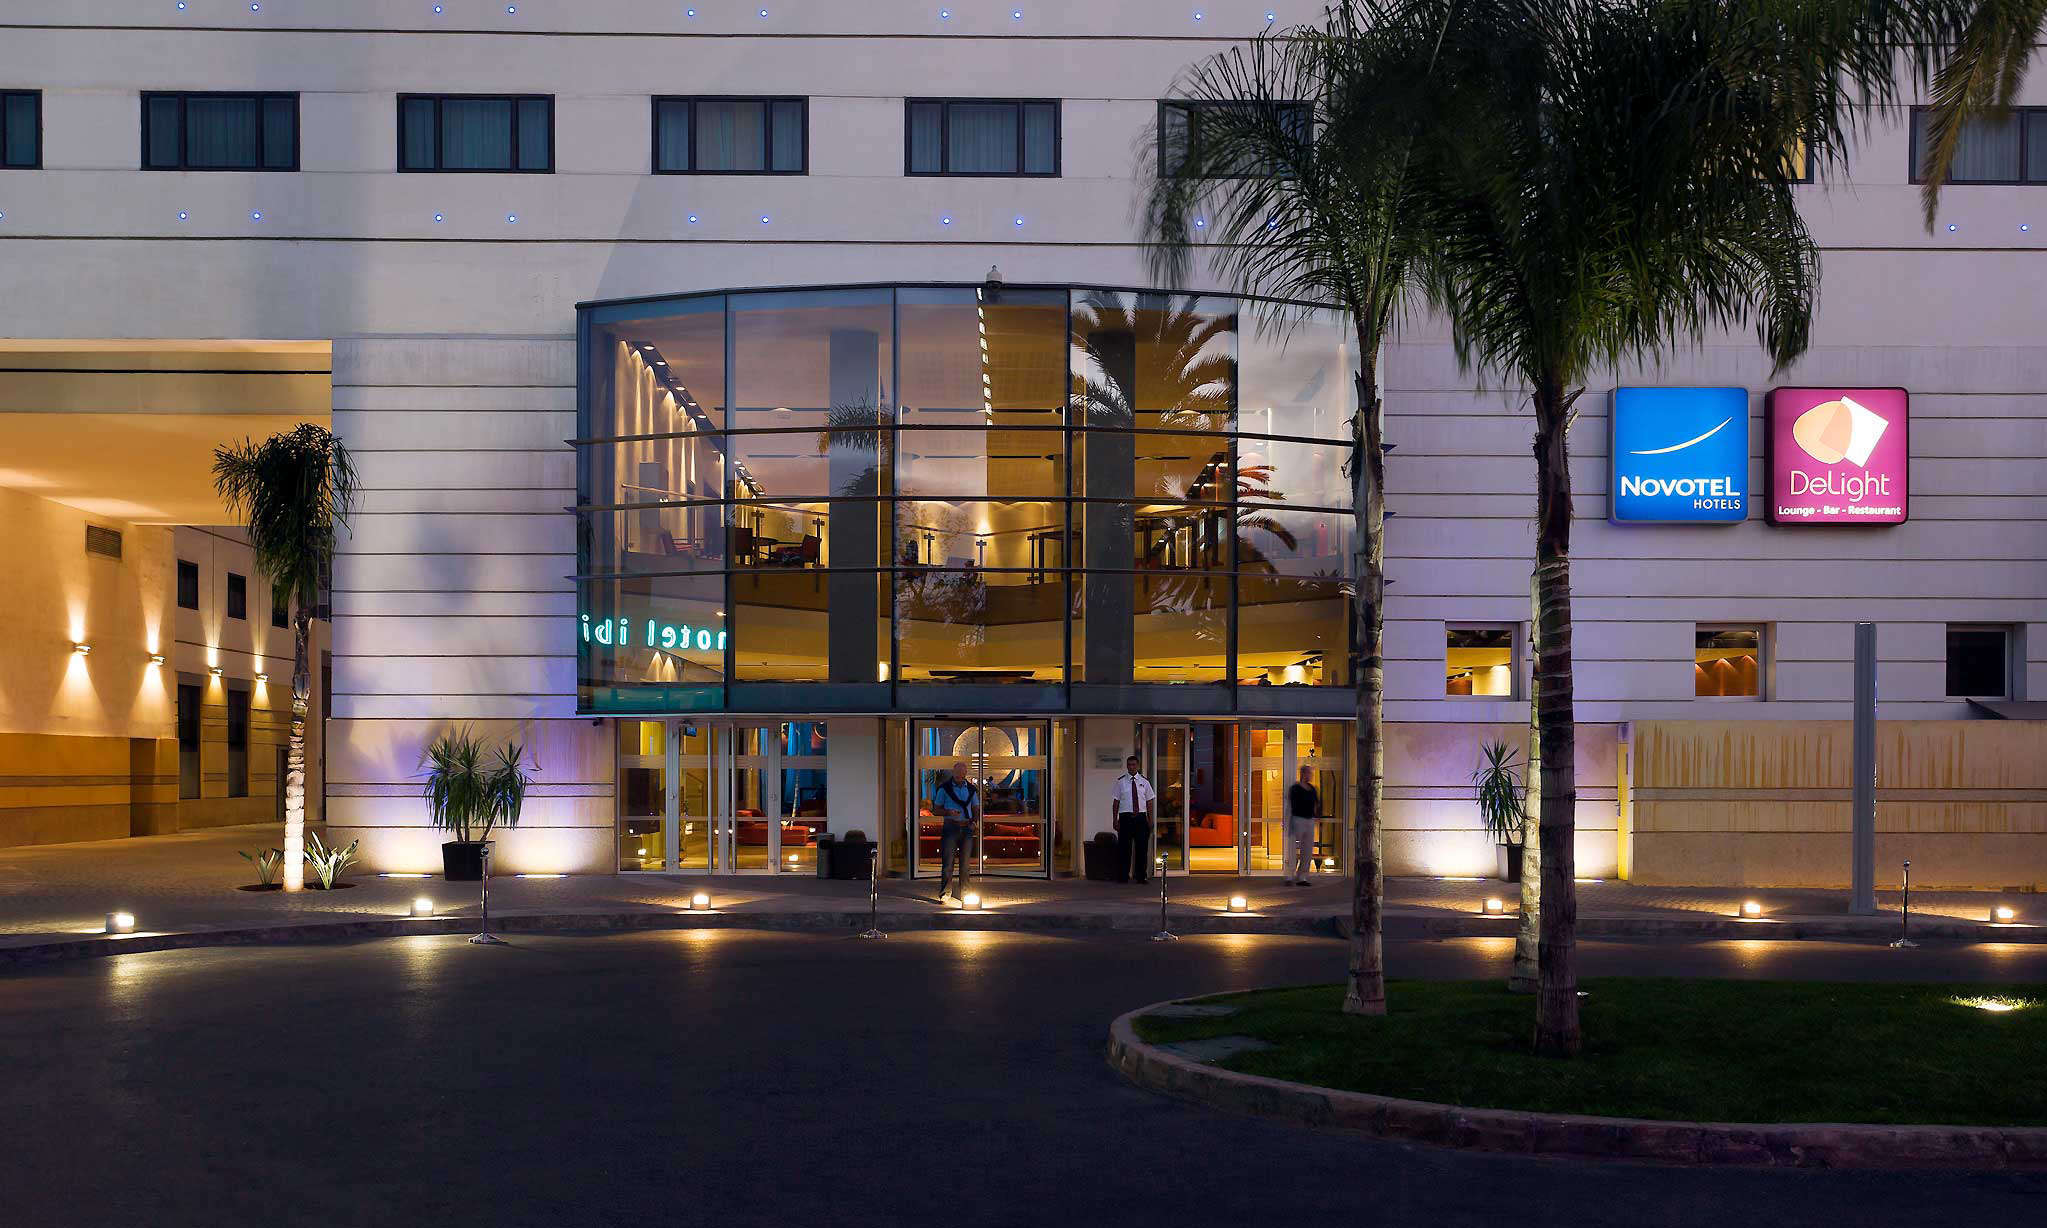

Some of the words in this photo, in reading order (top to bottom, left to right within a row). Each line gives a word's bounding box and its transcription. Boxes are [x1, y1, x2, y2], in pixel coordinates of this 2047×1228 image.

[1620, 475, 1741, 497] NOVOTEL
[1790, 470, 1891, 503] DeLight
[1693, 498, 1741, 510] HOTELS
[1778, 505, 1815, 517] Lounge
[1823, 505, 1840, 515] Bar
[1847, 505, 1902, 515] Restaurant
